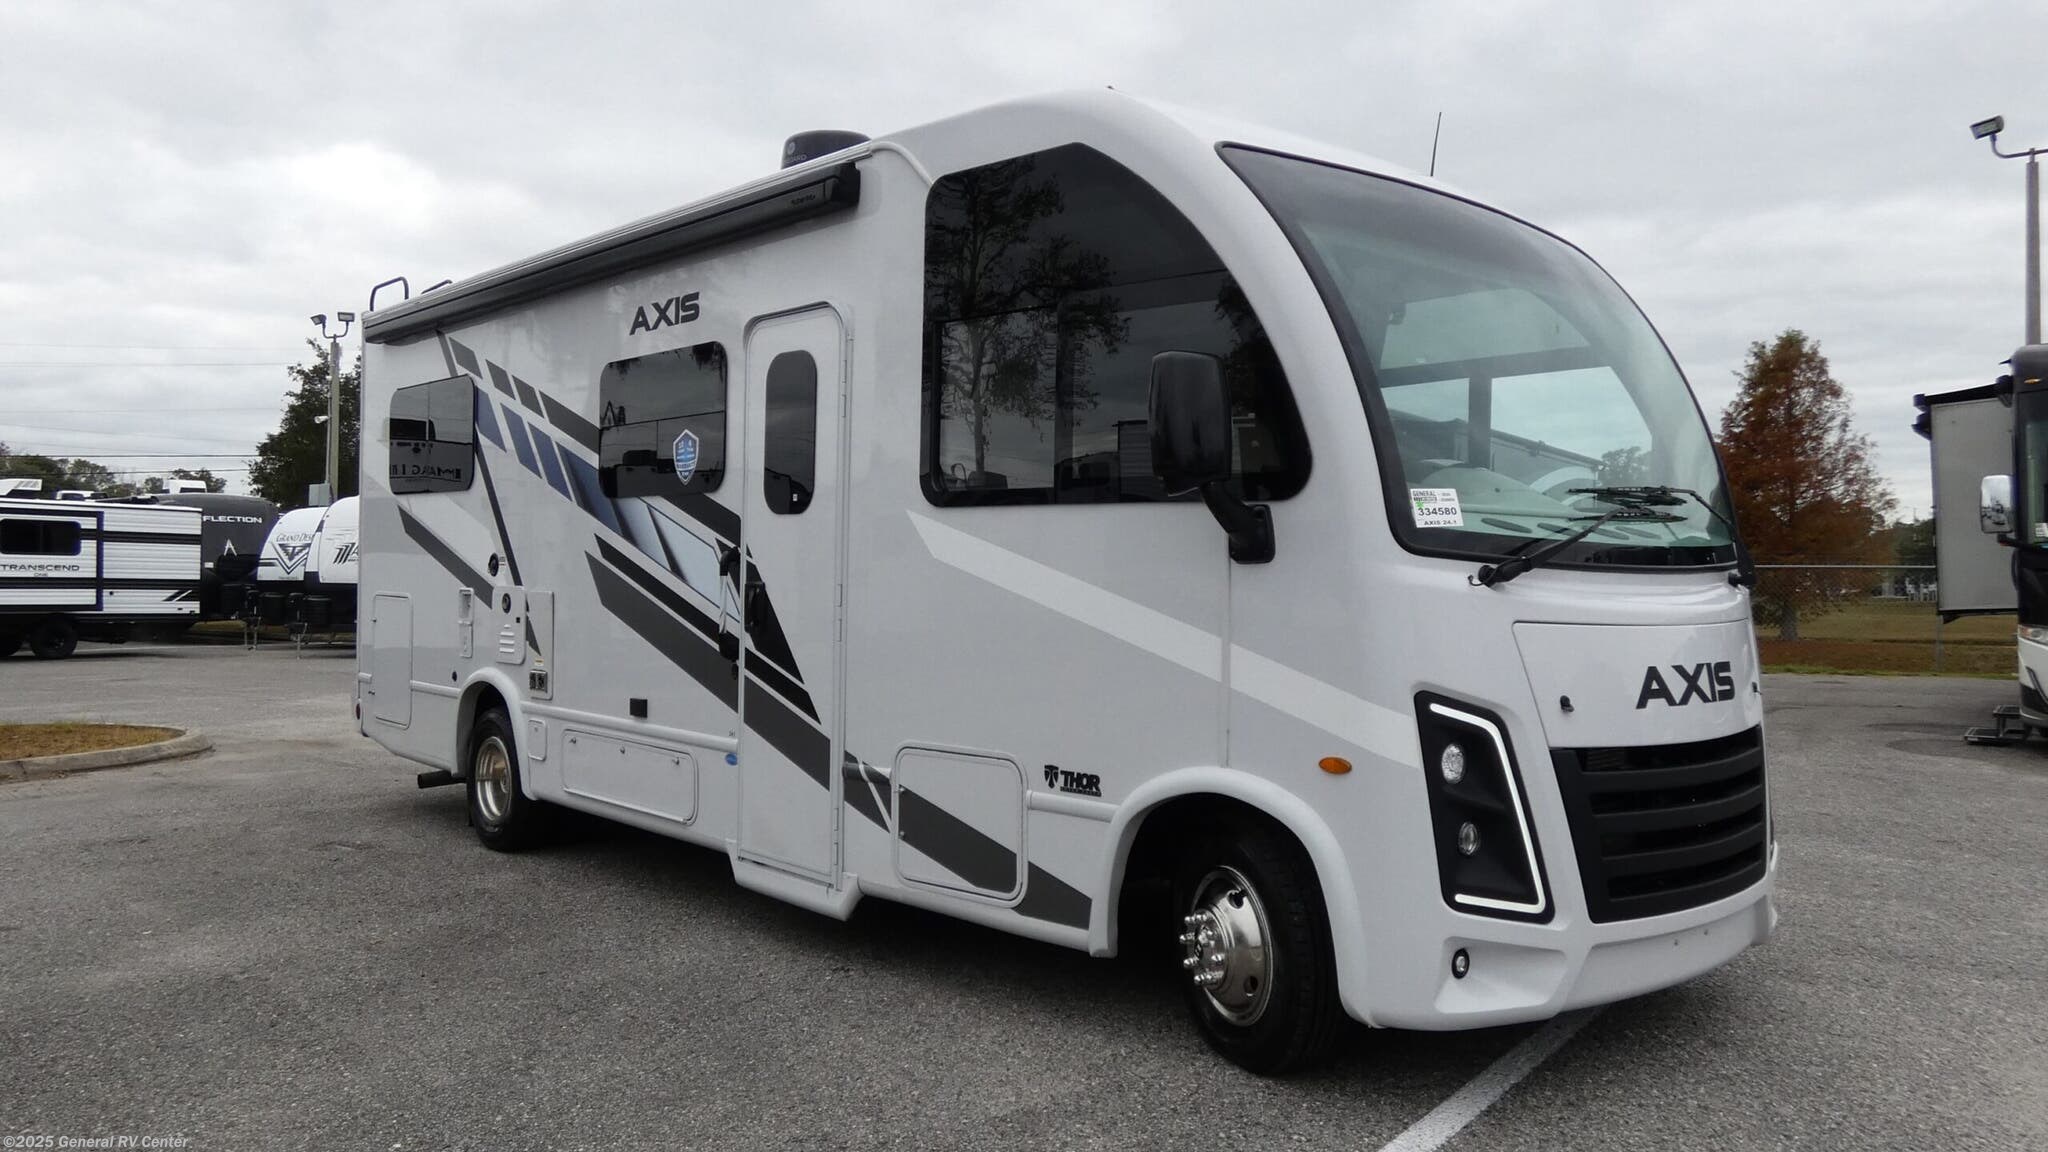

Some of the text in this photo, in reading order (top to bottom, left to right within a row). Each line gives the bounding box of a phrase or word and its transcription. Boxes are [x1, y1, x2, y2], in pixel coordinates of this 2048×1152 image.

[629, 291, 700, 336] AXIS
[1418, 507, 1457, 516] 334580
[1636, 661, 1735, 709] AXIS
[1060, 770, 1101, 792] THOR
